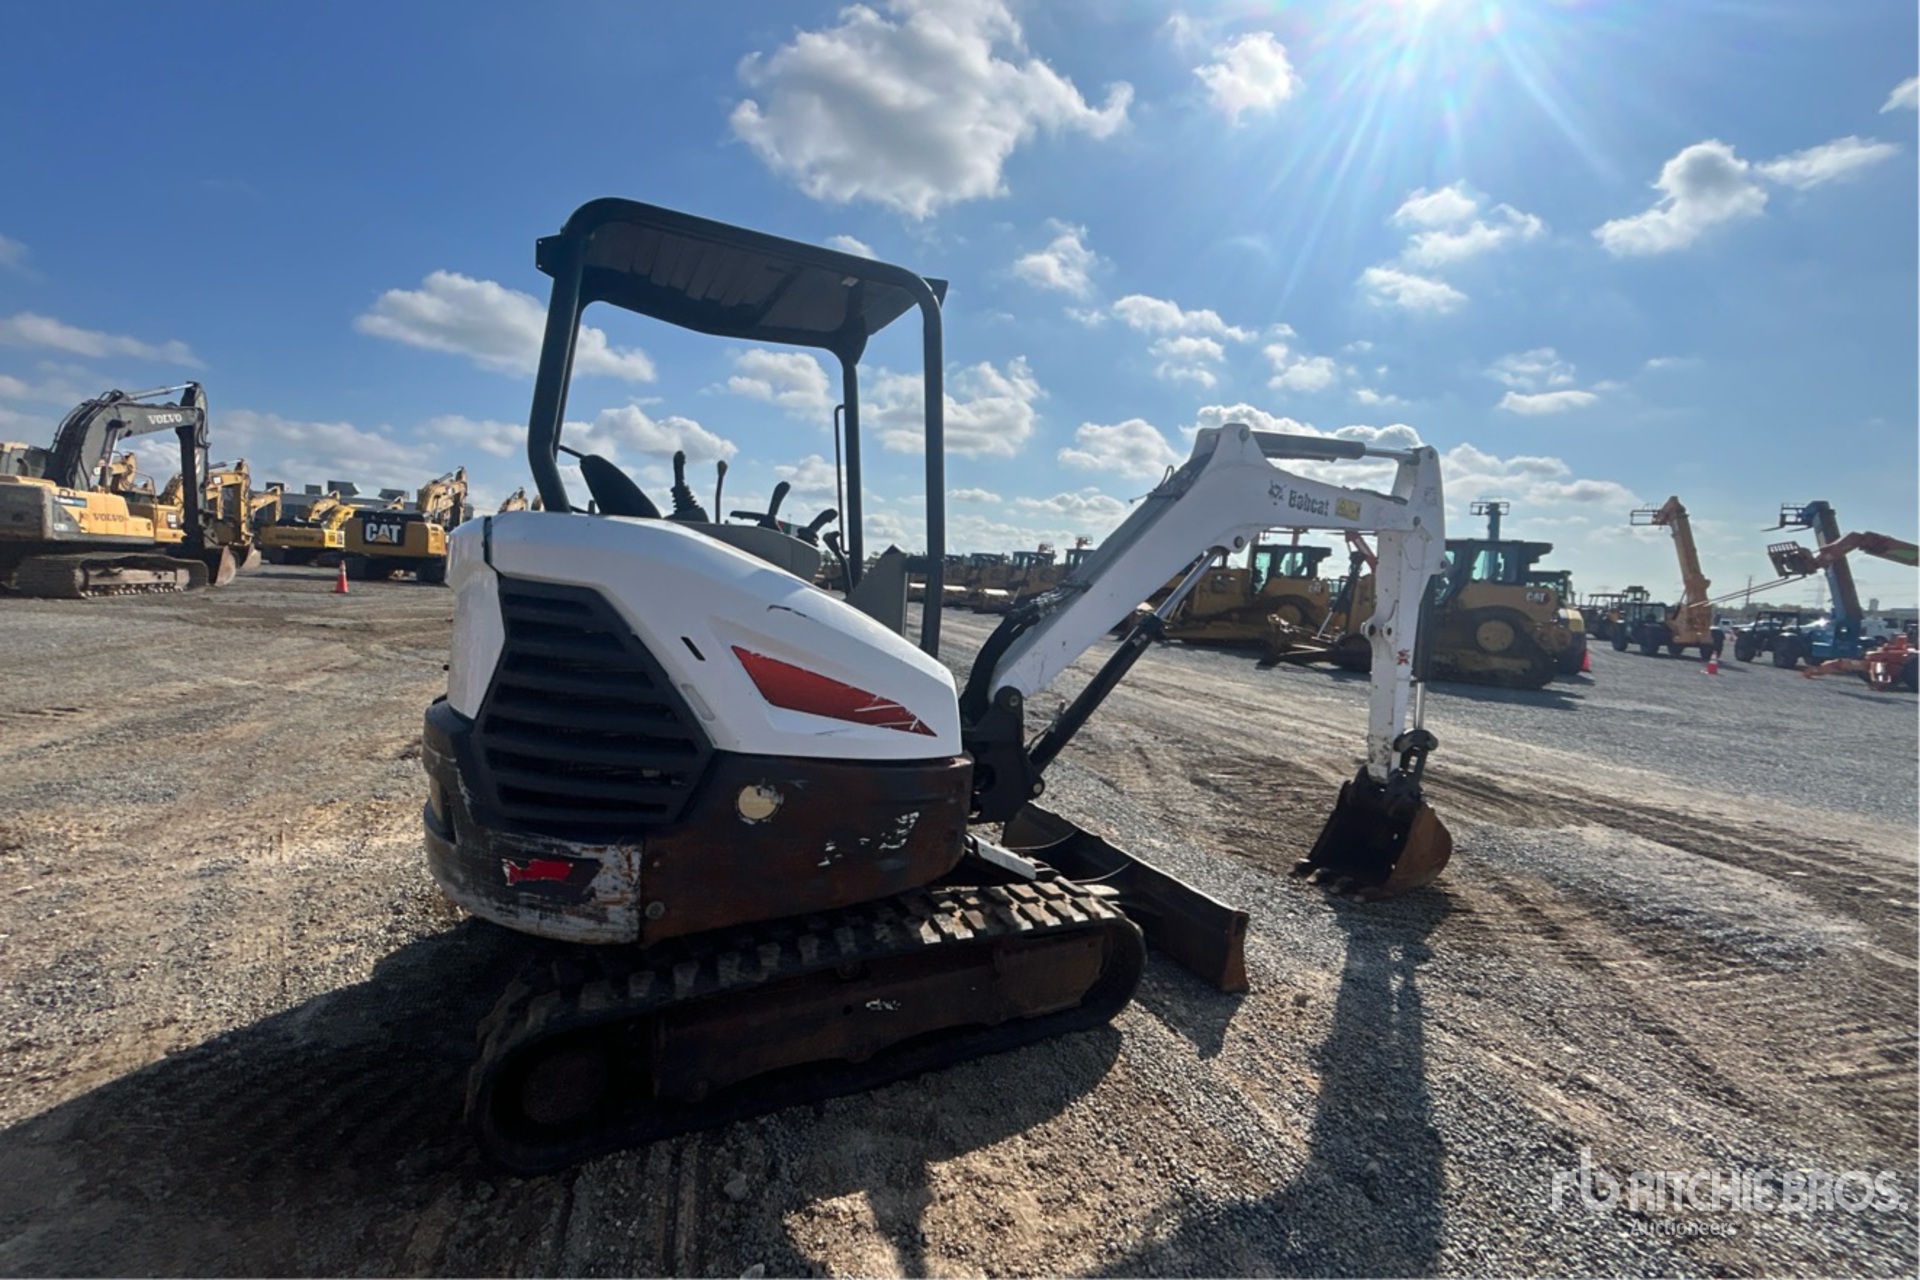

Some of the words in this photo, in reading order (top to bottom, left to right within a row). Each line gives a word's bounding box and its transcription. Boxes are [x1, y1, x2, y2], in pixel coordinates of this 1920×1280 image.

[147, 413, 183, 425] VOLVO
[1288, 489, 1330, 517] Bobcat
[93, 512, 124, 522] VOLVO
[365, 523, 401, 543] CAT
[1526, 591, 1546, 603] CAT
